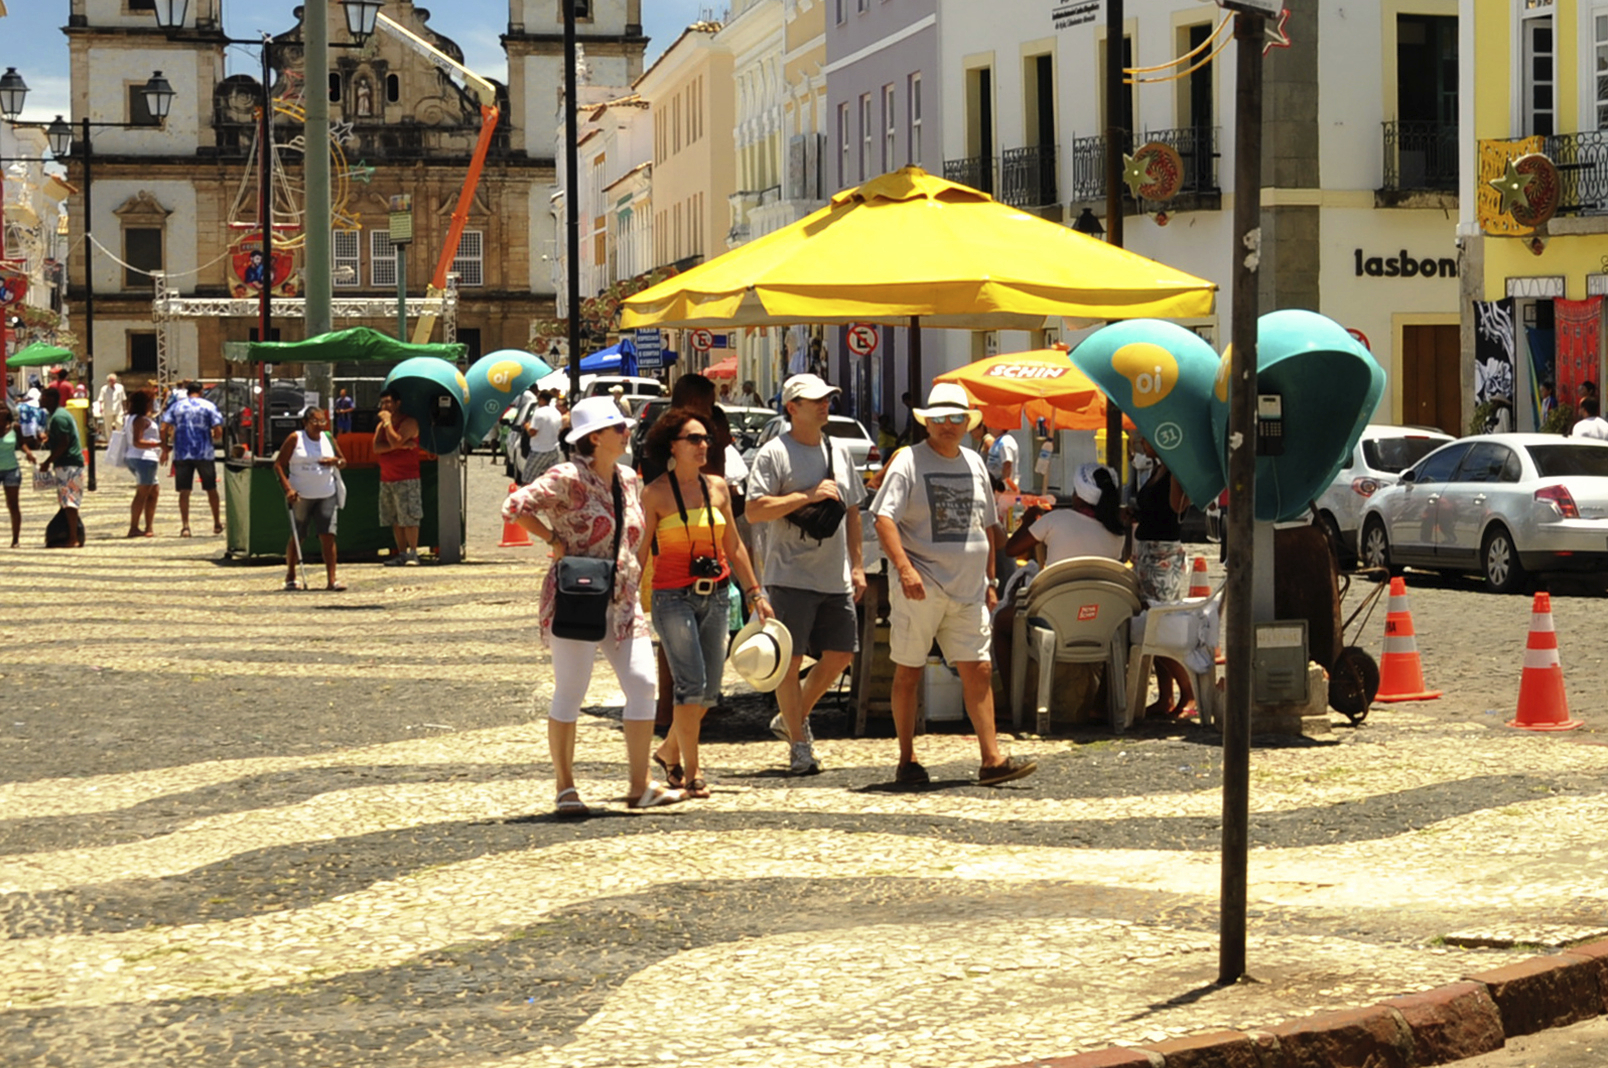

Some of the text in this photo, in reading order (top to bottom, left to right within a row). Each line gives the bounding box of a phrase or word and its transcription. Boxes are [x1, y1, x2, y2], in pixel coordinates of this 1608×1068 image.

[1354, 248, 1460, 278] lasbon
[493, 370, 509, 385] oi
[989, 364, 1065, 379] SCHIN
[1136, 365, 1162, 394] oi
[1160, 428, 1178, 444] 31
